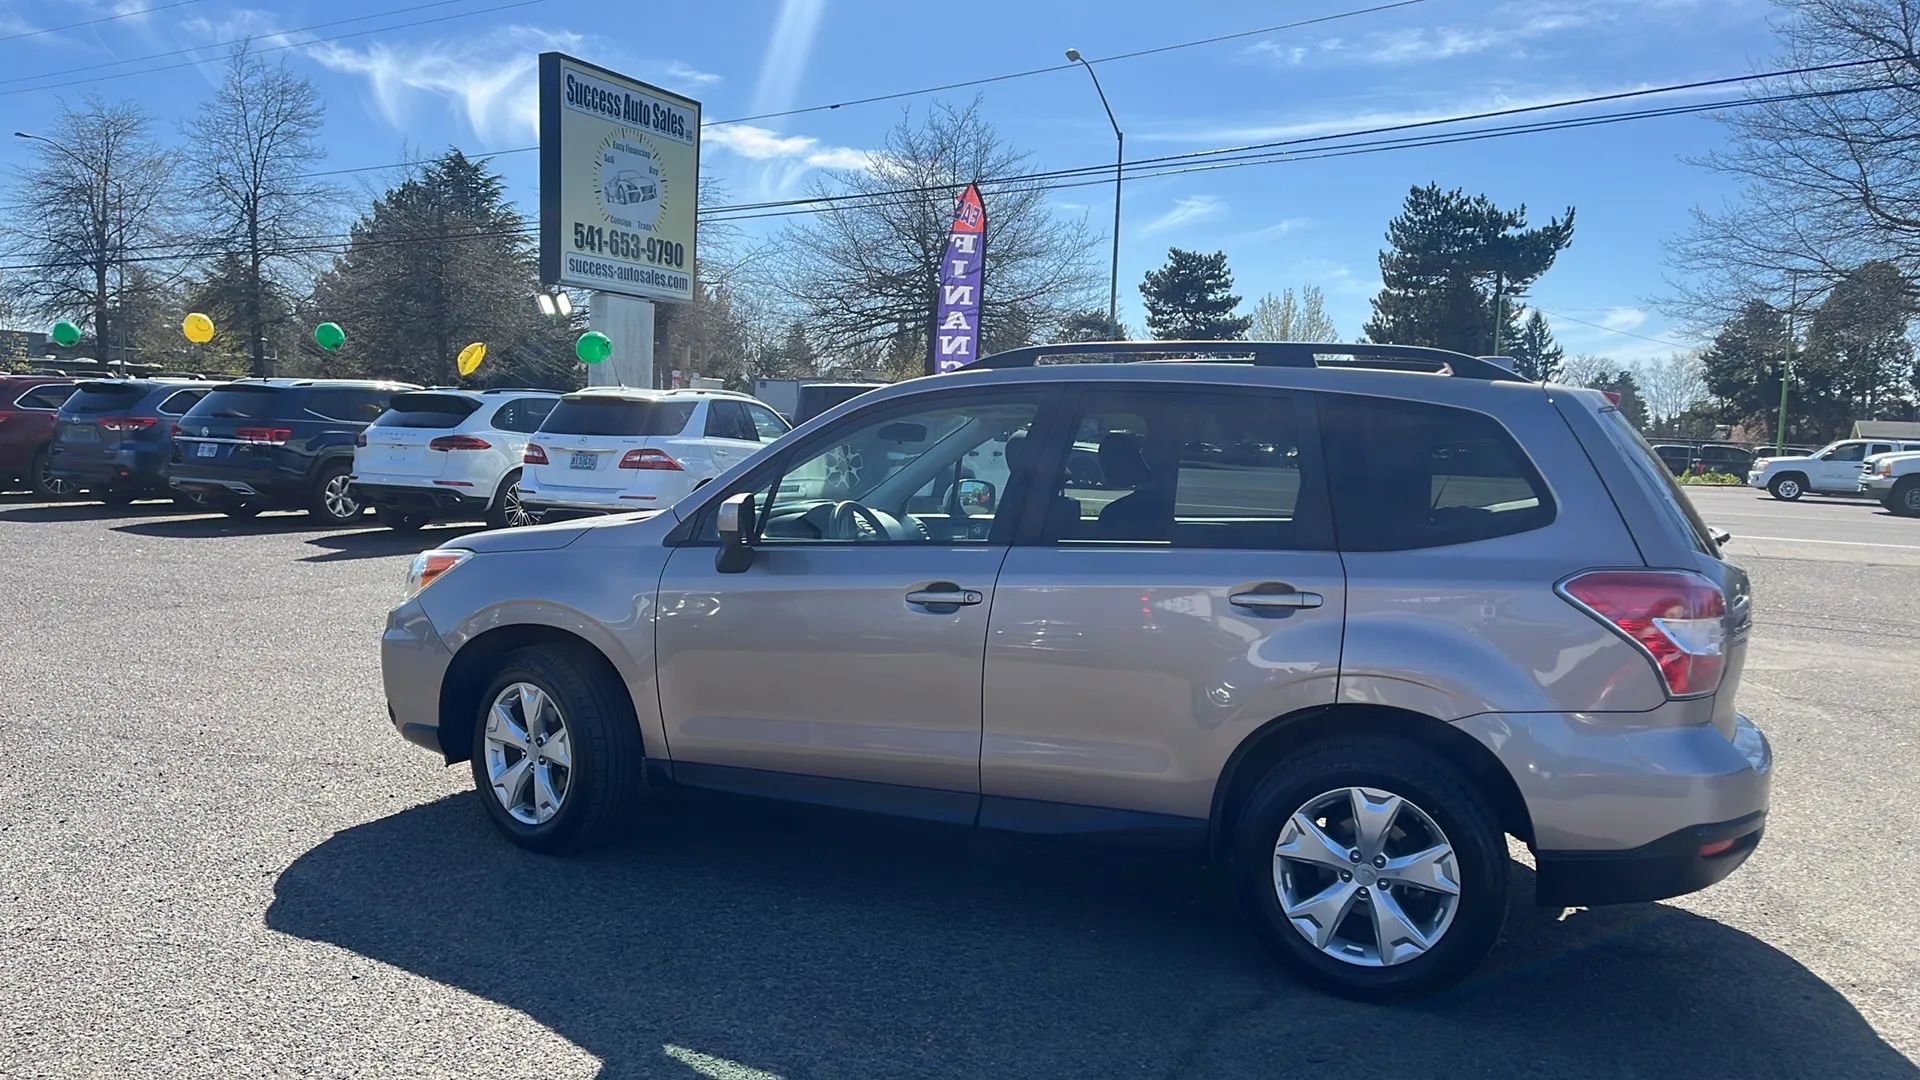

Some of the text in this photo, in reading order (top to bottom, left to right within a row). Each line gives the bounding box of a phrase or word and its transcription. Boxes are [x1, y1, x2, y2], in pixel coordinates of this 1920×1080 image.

[566, 73, 621, 119] Success
[623, 93, 650, 127] Auto
[652, 102, 684, 138] Sales
[625, 144, 651, 160] Financing
[573, 221, 685, 268] 541-653-9790
[568, 258, 688, 291] success-autosales.com
